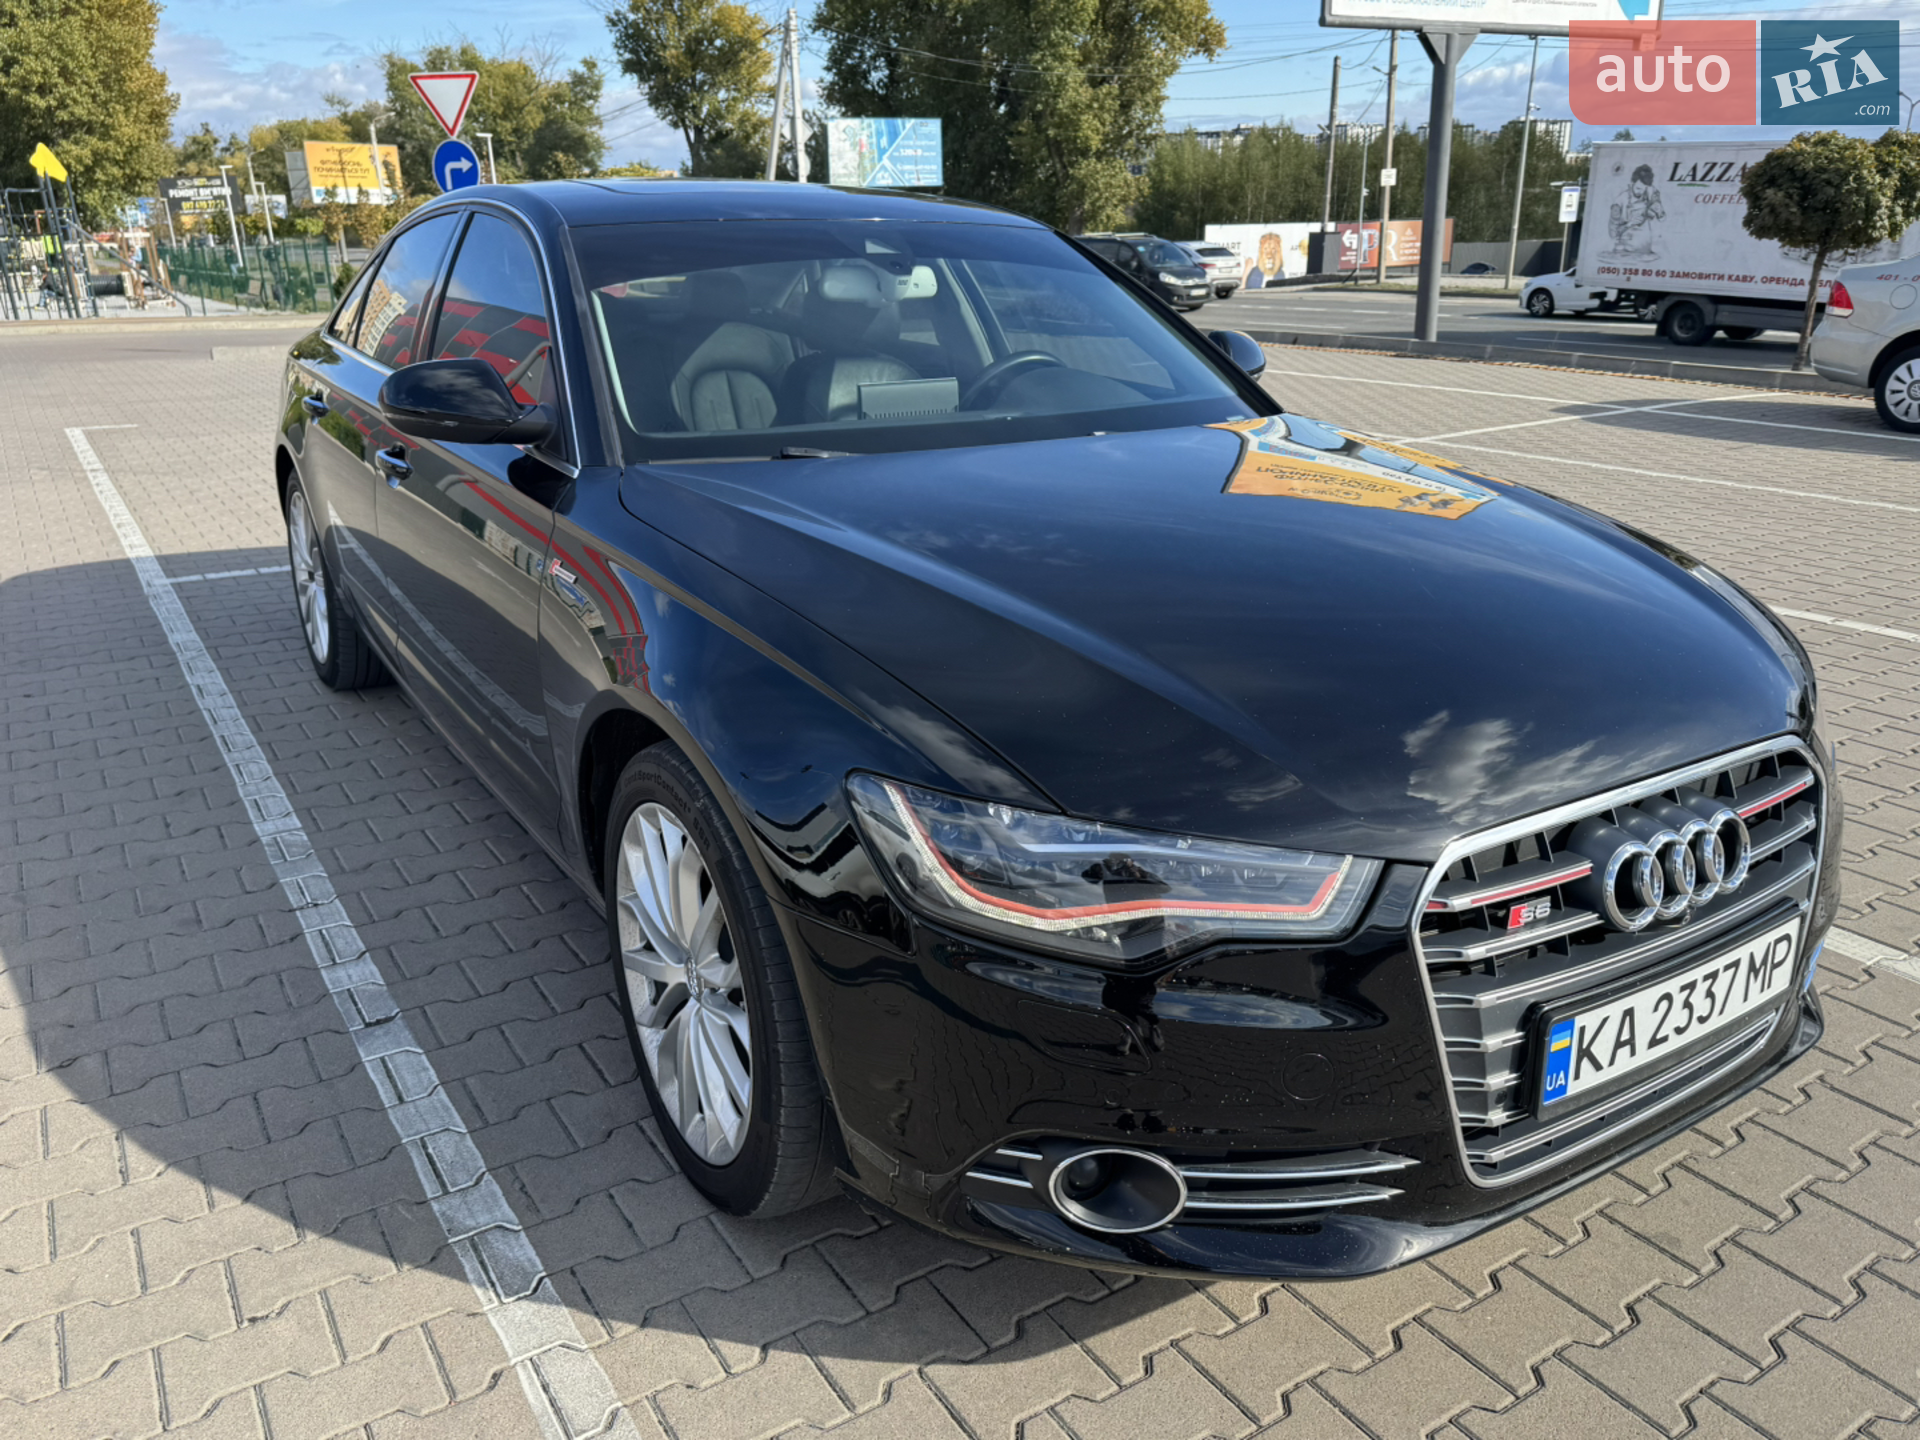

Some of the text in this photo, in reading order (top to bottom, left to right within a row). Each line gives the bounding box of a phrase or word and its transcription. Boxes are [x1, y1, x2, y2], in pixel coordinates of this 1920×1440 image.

[1597, 266, 1620, 276] (050)
[1622, 267, 1639, 277] 358
[1641, 268, 1653, 278] 80
[1655, 269, 1667, 278] 60
[1669, 270, 1725, 282] ЗАМОВИТИ
[1761, 275, 1805, 288] ОРЕНДА
[1517, 902, 1551, 924] S6
[1573, 932, 1793, 1082] KA 2337 MP
[1545, 1070, 1567, 1092] UA
